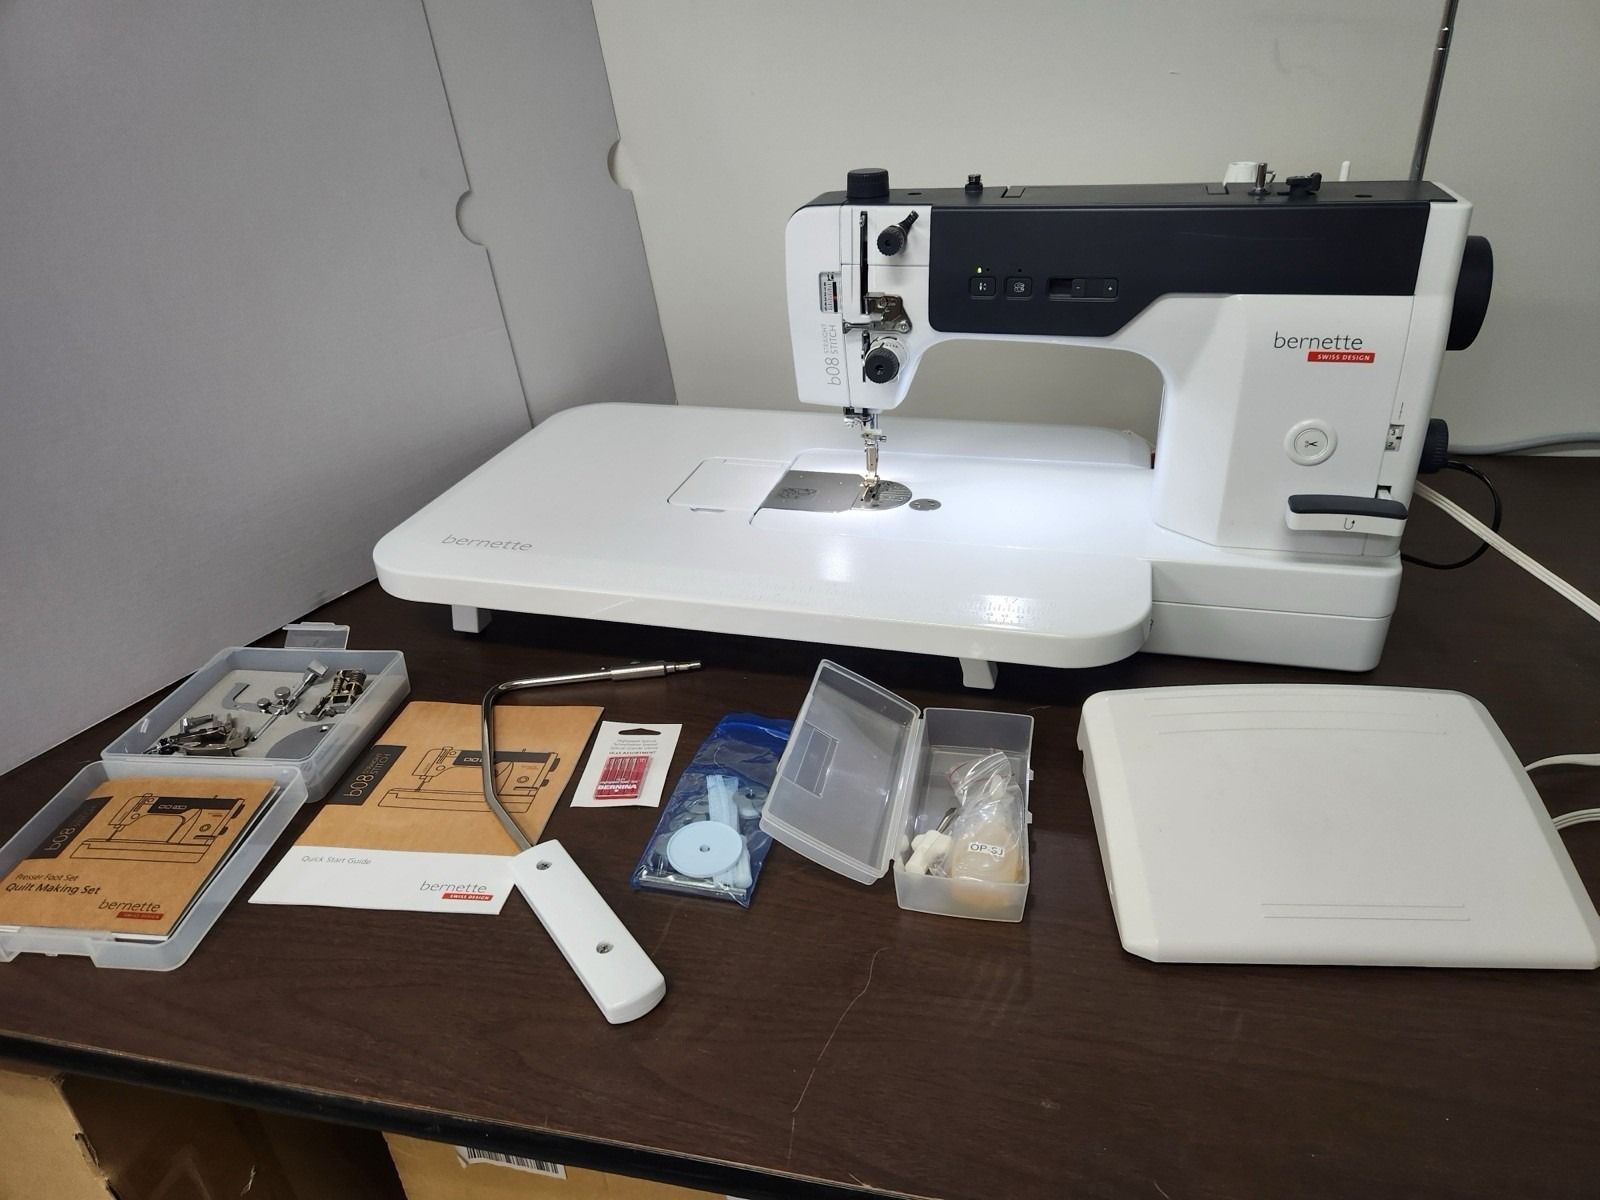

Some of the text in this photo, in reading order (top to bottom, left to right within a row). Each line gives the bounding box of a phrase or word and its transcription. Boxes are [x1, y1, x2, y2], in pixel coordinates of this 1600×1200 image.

[829, 324, 839, 355] STITCH
[1273, 330, 1363, 350] bernette
[824, 357, 842, 386] b08
[440, 534, 533, 551] bernette
[343, 774, 375, 797] b08
[44, 826, 76, 851] b08
[970, 843, 1003, 856] OP-SJ
[301, 855, 372, 865] Quick Start Guide
[15, 872, 79, 881] Presser Foot Set
[5, 882, 101, 895] Quilt Making Set
[419, 879, 487, 894] bernette
[98, 898, 161, 913] bernette
